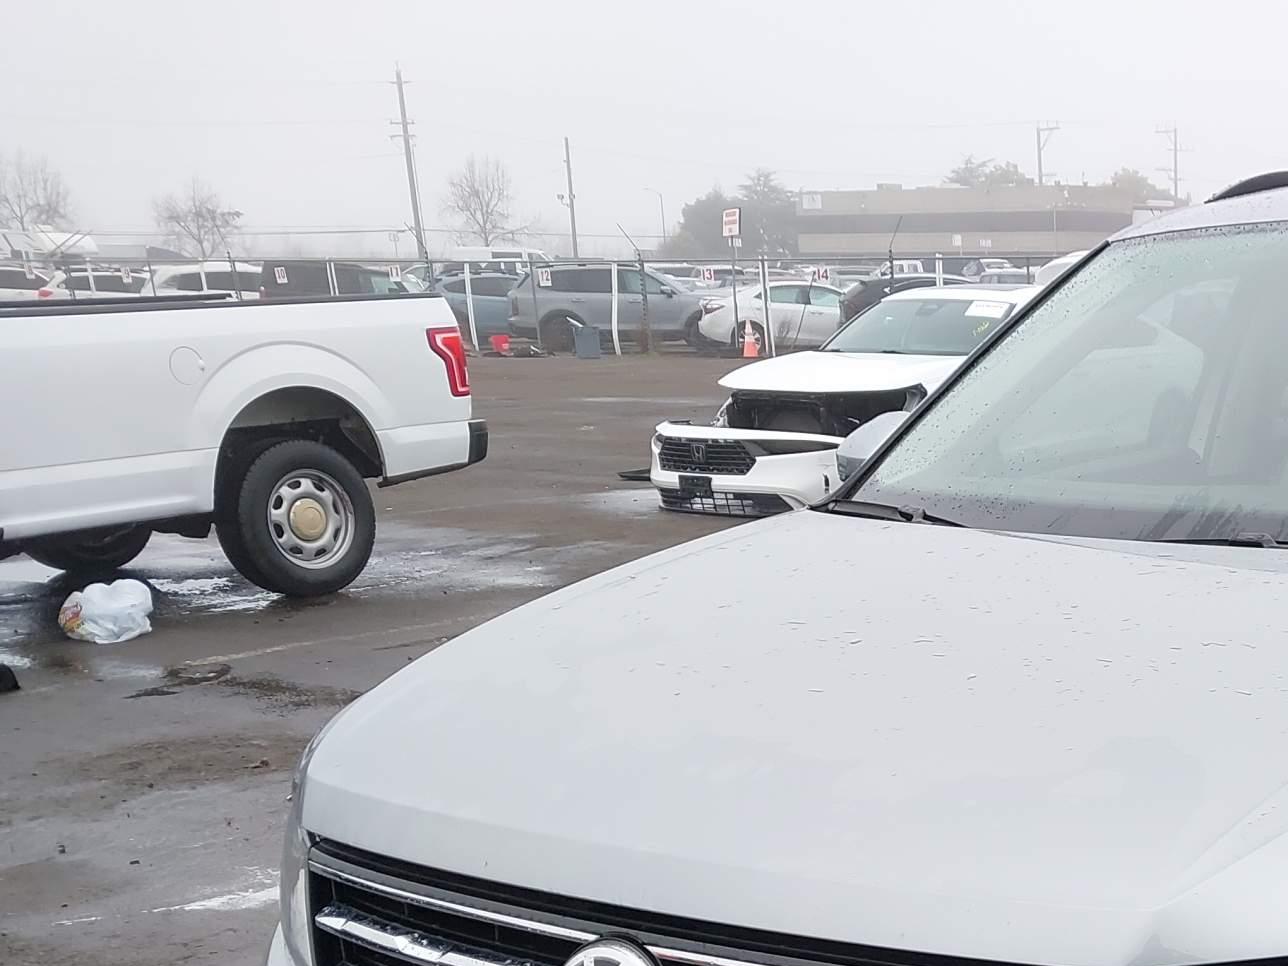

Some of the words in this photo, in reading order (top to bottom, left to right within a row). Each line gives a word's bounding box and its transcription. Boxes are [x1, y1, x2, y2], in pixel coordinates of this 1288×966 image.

[540, 269, 550, 282] 12
[702, 269, 713, 281] 13
[816, 268, 829, 281] 14
